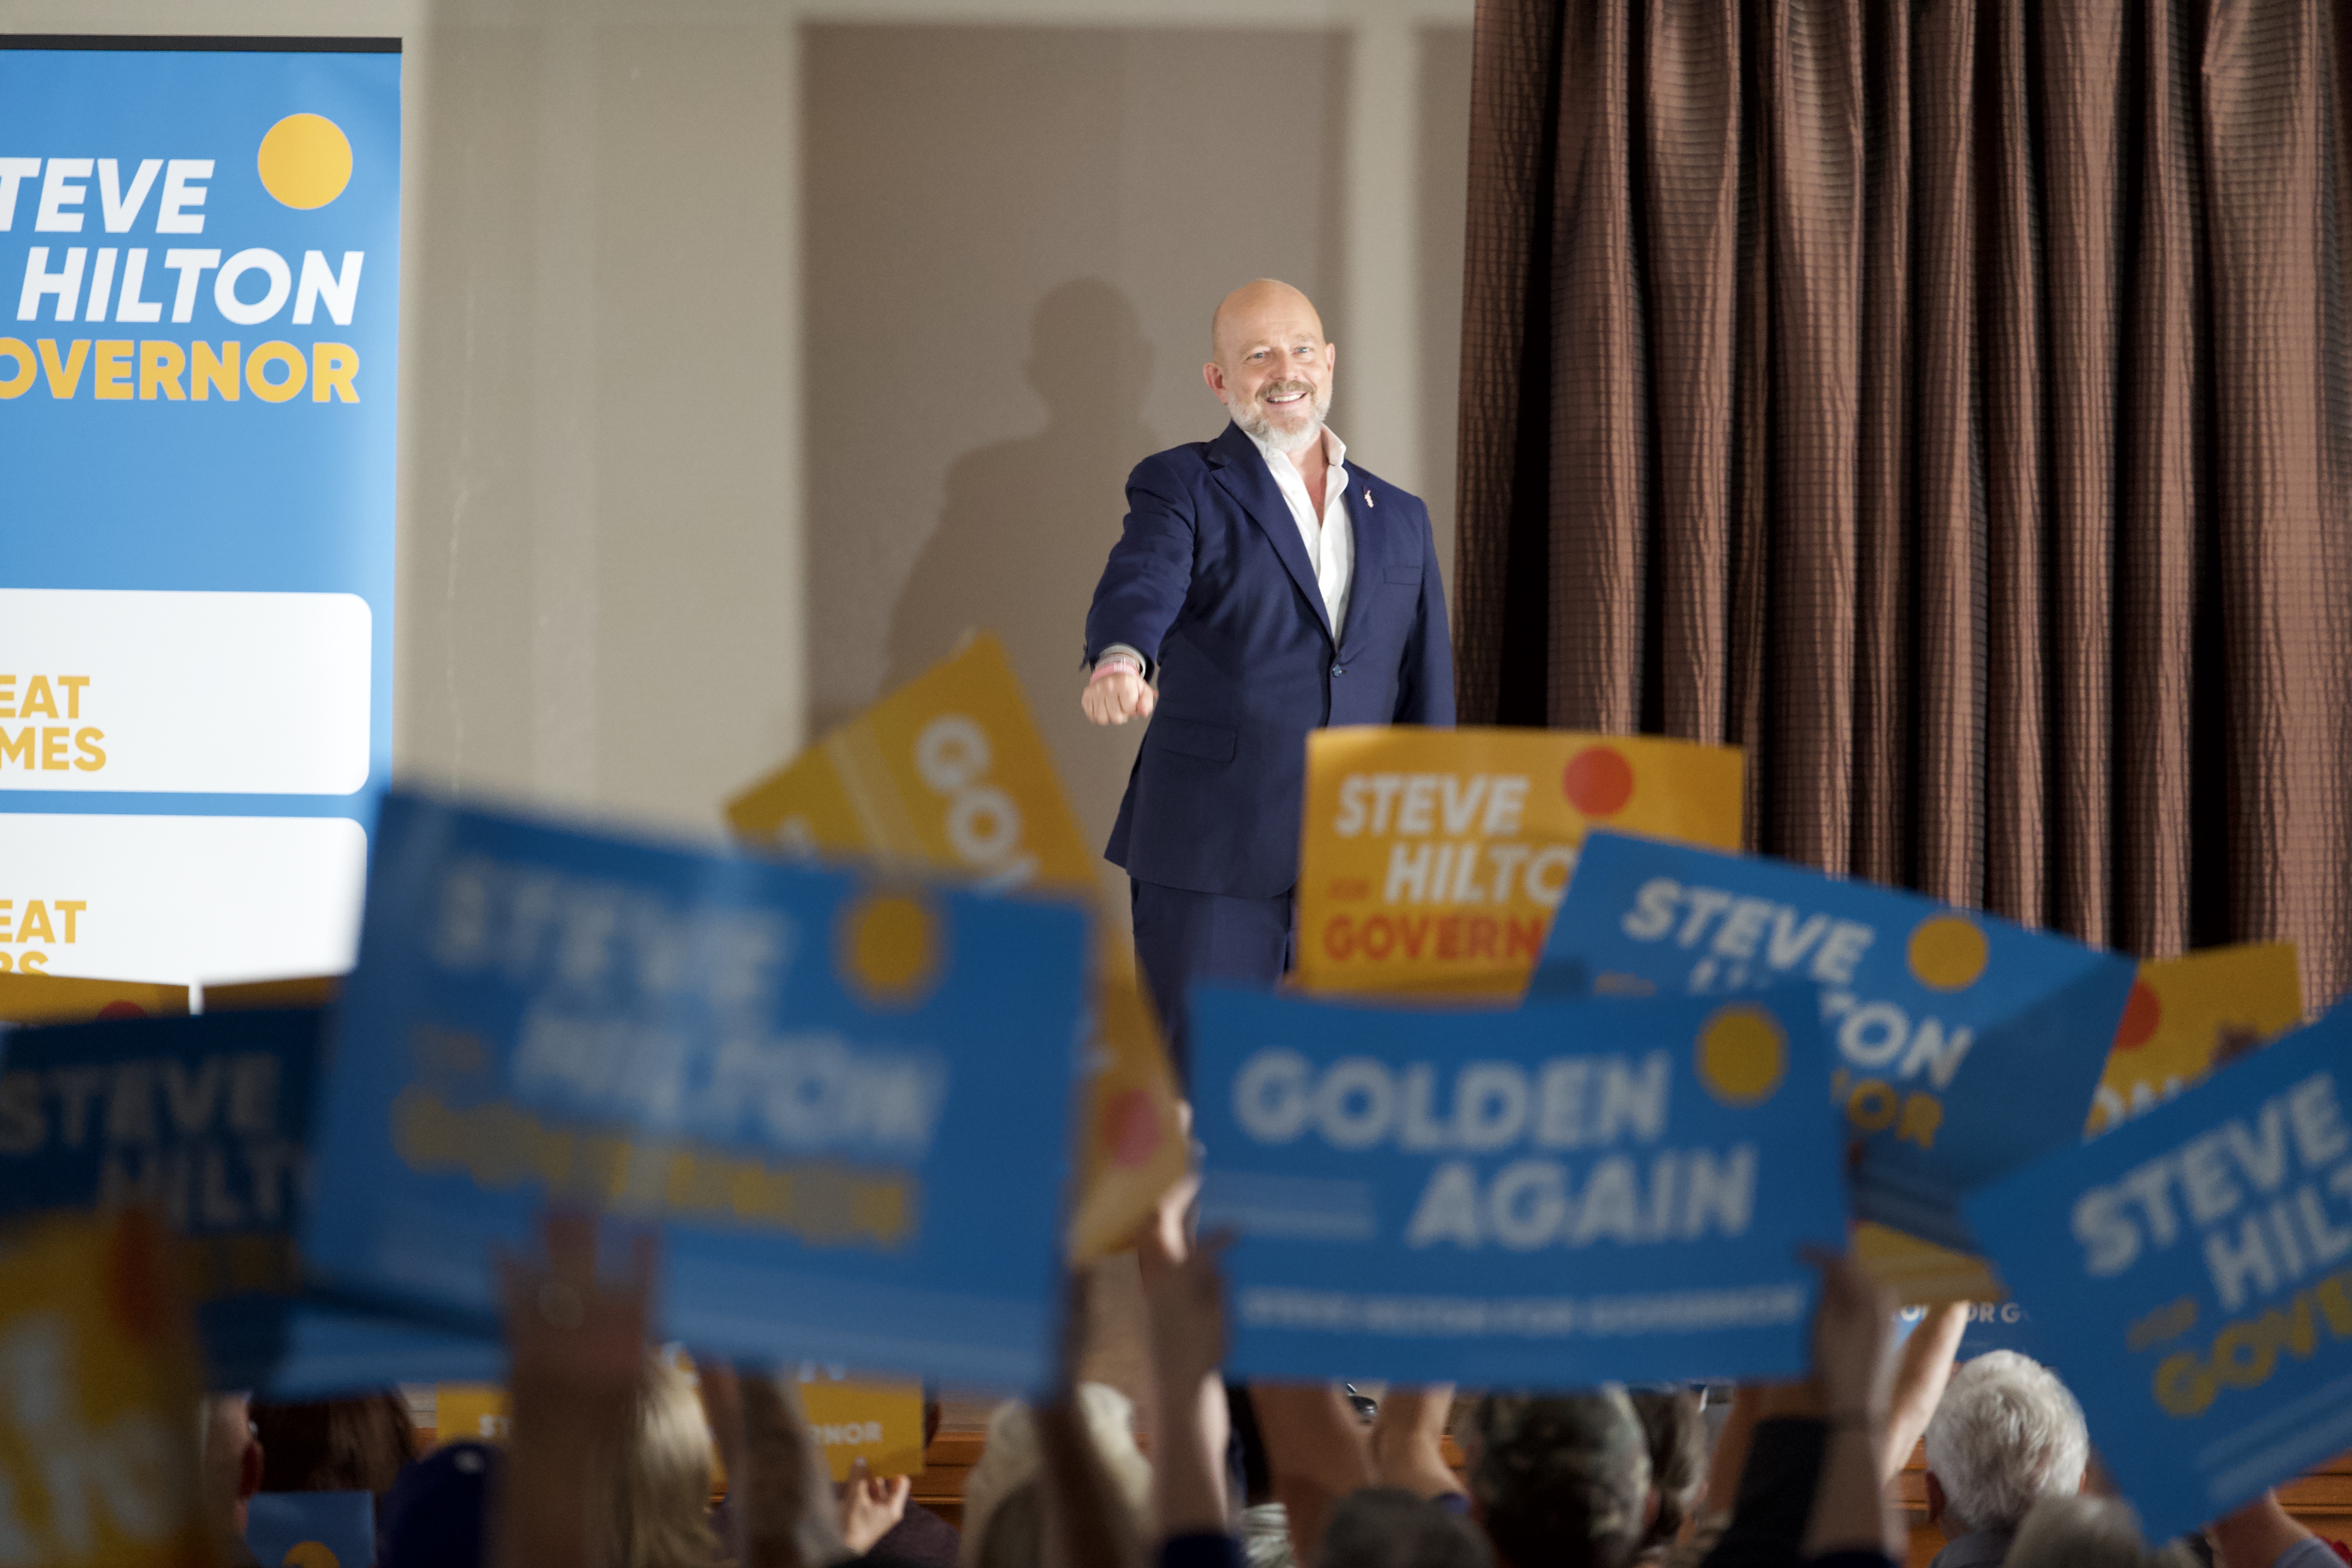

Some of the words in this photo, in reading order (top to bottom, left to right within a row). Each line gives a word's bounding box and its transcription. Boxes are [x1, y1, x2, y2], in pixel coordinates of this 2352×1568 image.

[16, 247, 365, 326] HILTON
[1334, 772, 1531, 838] STEVE
[1621, 876, 1877, 986] STEVE
[1232, 1047, 1671, 1151] GOLDEN
[1405, 1144, 1759, 1250] AGAIN
[2070, 1070, 2352, 1276] STEVE
